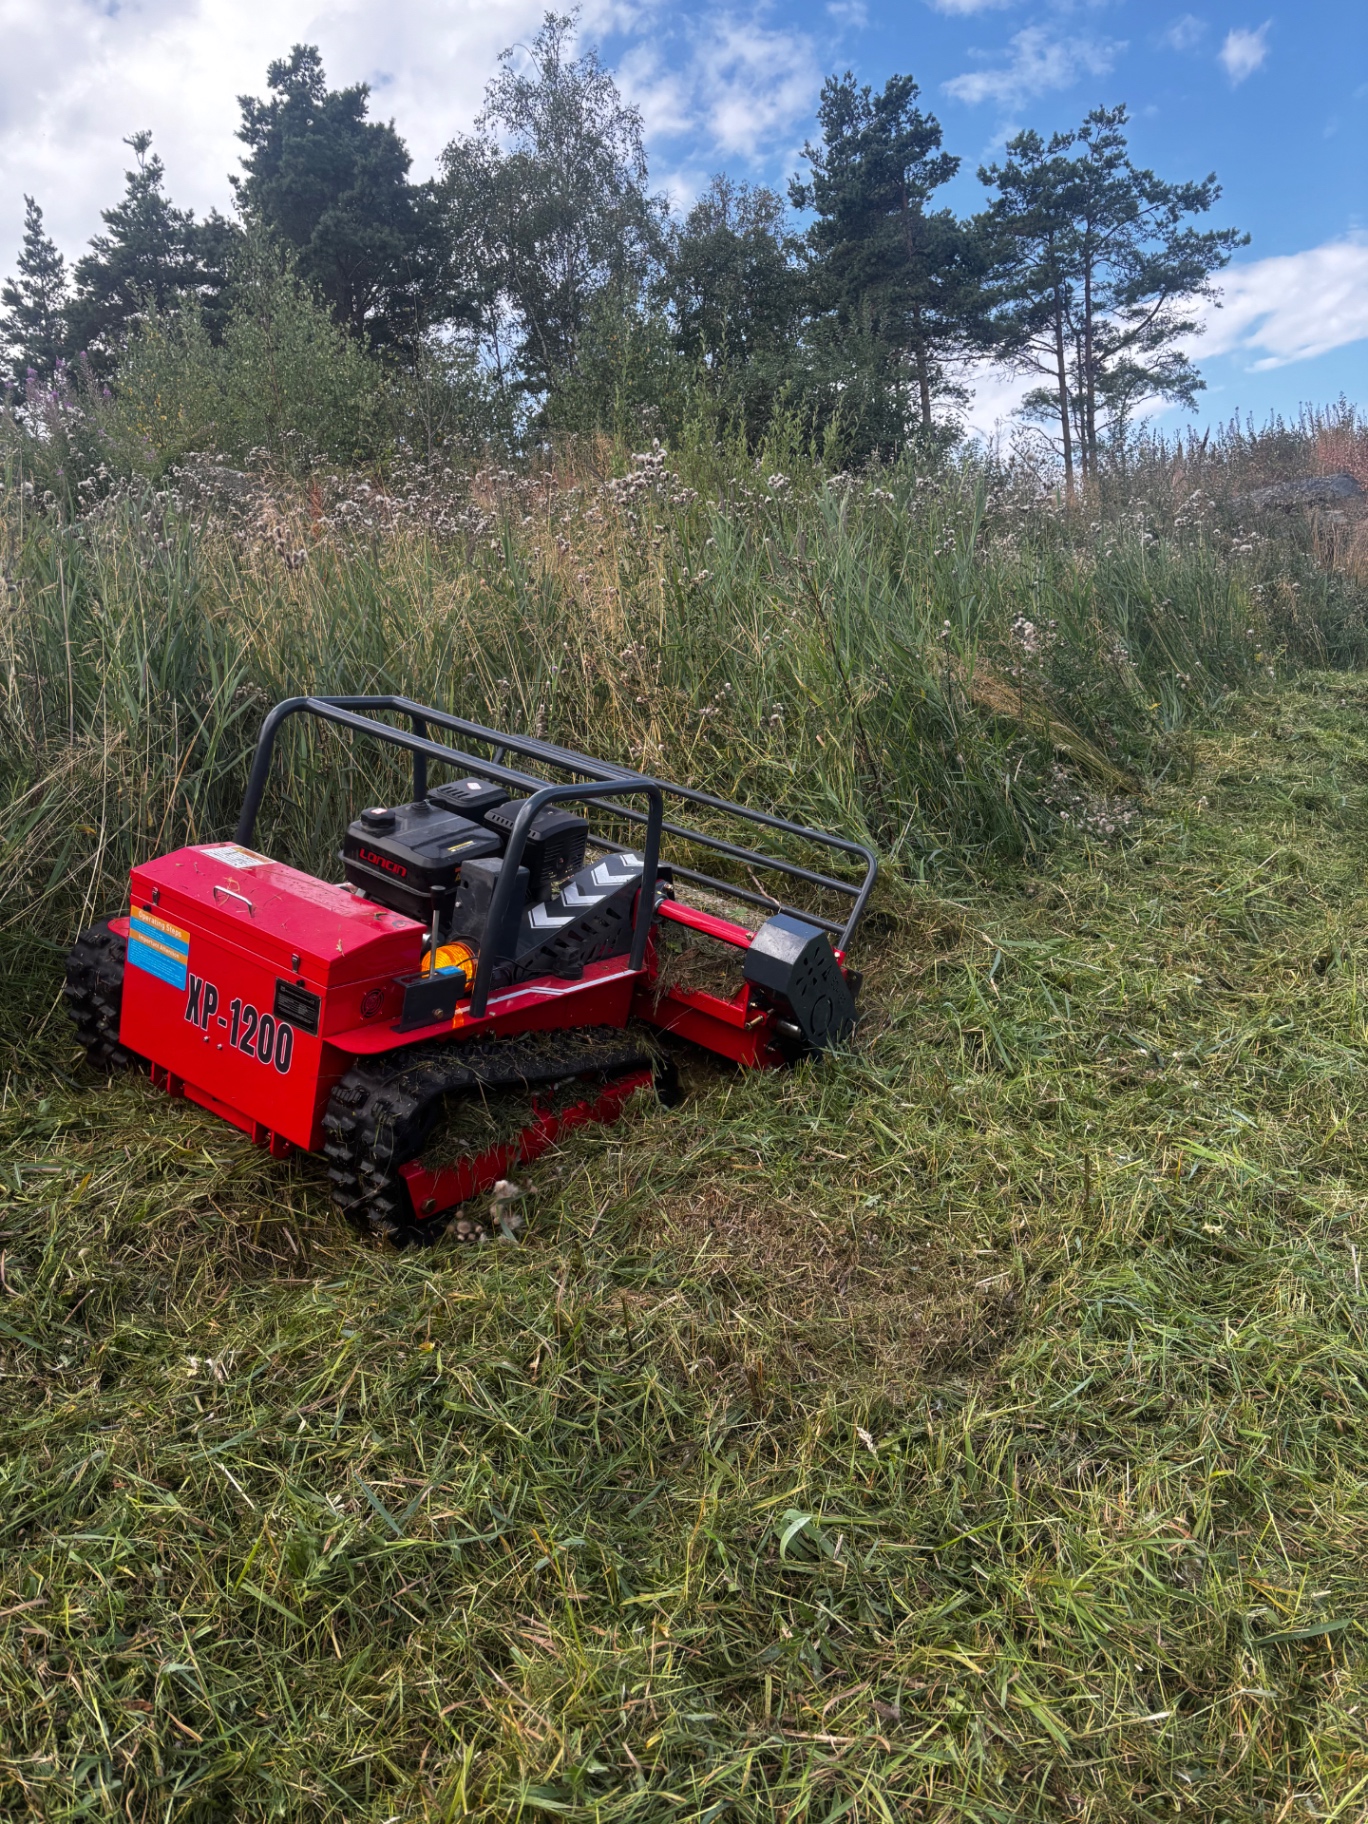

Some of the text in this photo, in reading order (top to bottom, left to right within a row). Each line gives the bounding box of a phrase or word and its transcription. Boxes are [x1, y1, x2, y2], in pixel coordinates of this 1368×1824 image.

[138, 910, 165, 931] Operating
[166, 923, 182, 938] Steps
[138, 934, 160, 949] Important
[184, 972, 294, 1075] XP-1200
